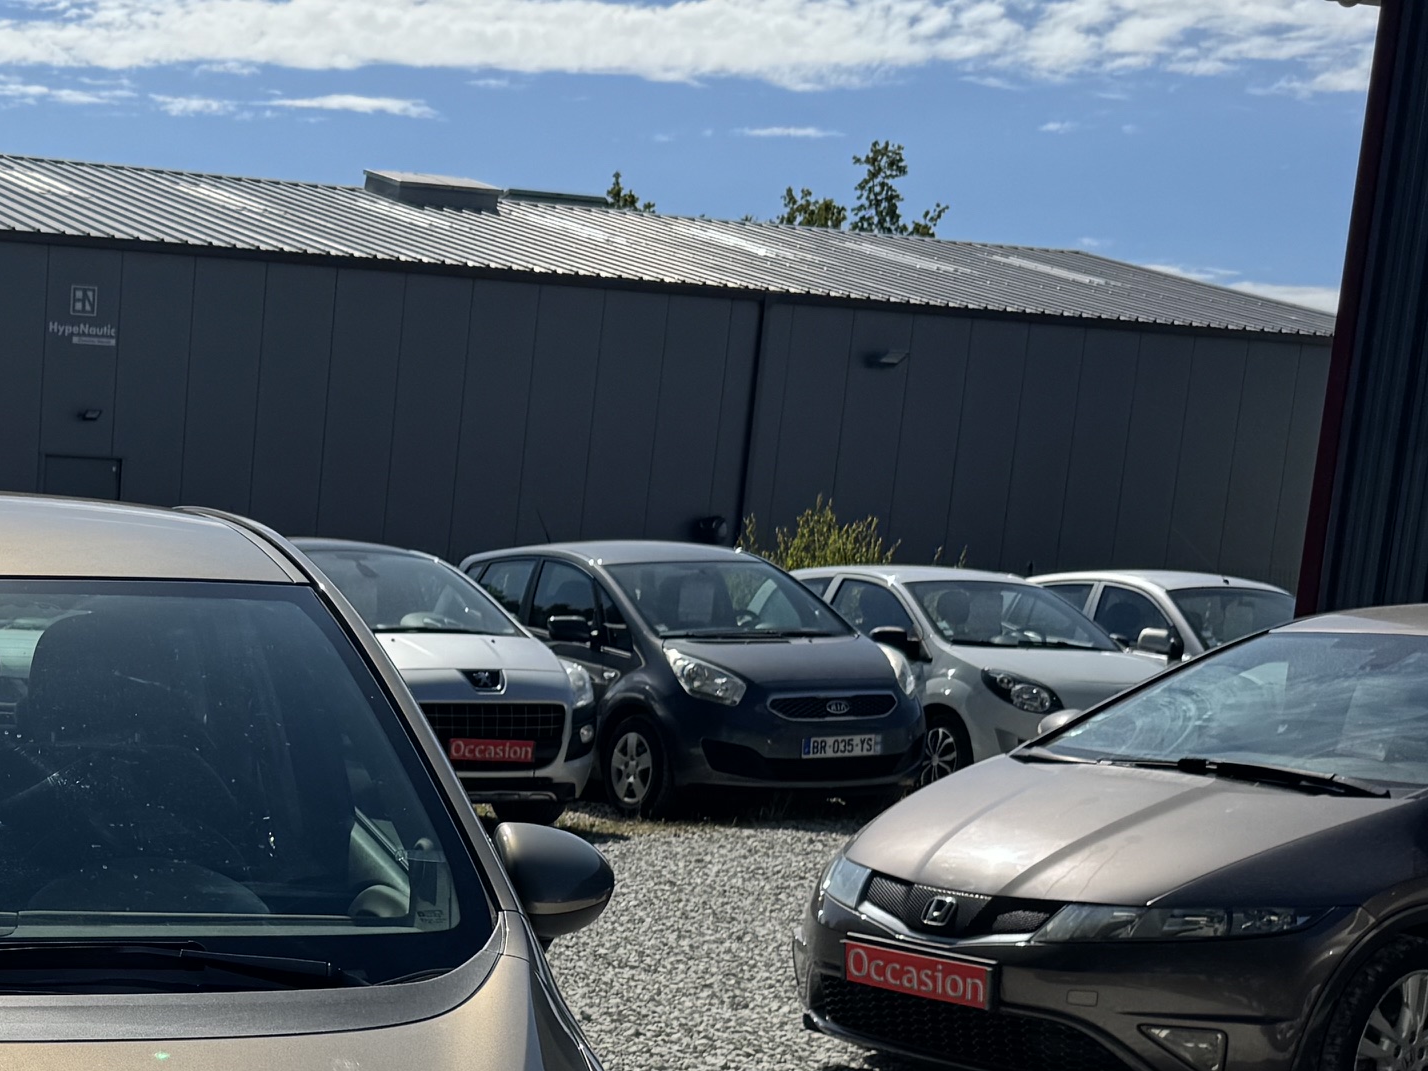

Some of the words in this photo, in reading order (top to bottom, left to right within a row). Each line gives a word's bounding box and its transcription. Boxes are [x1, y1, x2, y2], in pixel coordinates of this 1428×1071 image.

[49, 321, 115, 336] HypeNautic
[451, 740, 532, 759] Occasion
[848, 948, 984, 1002] Occasion
